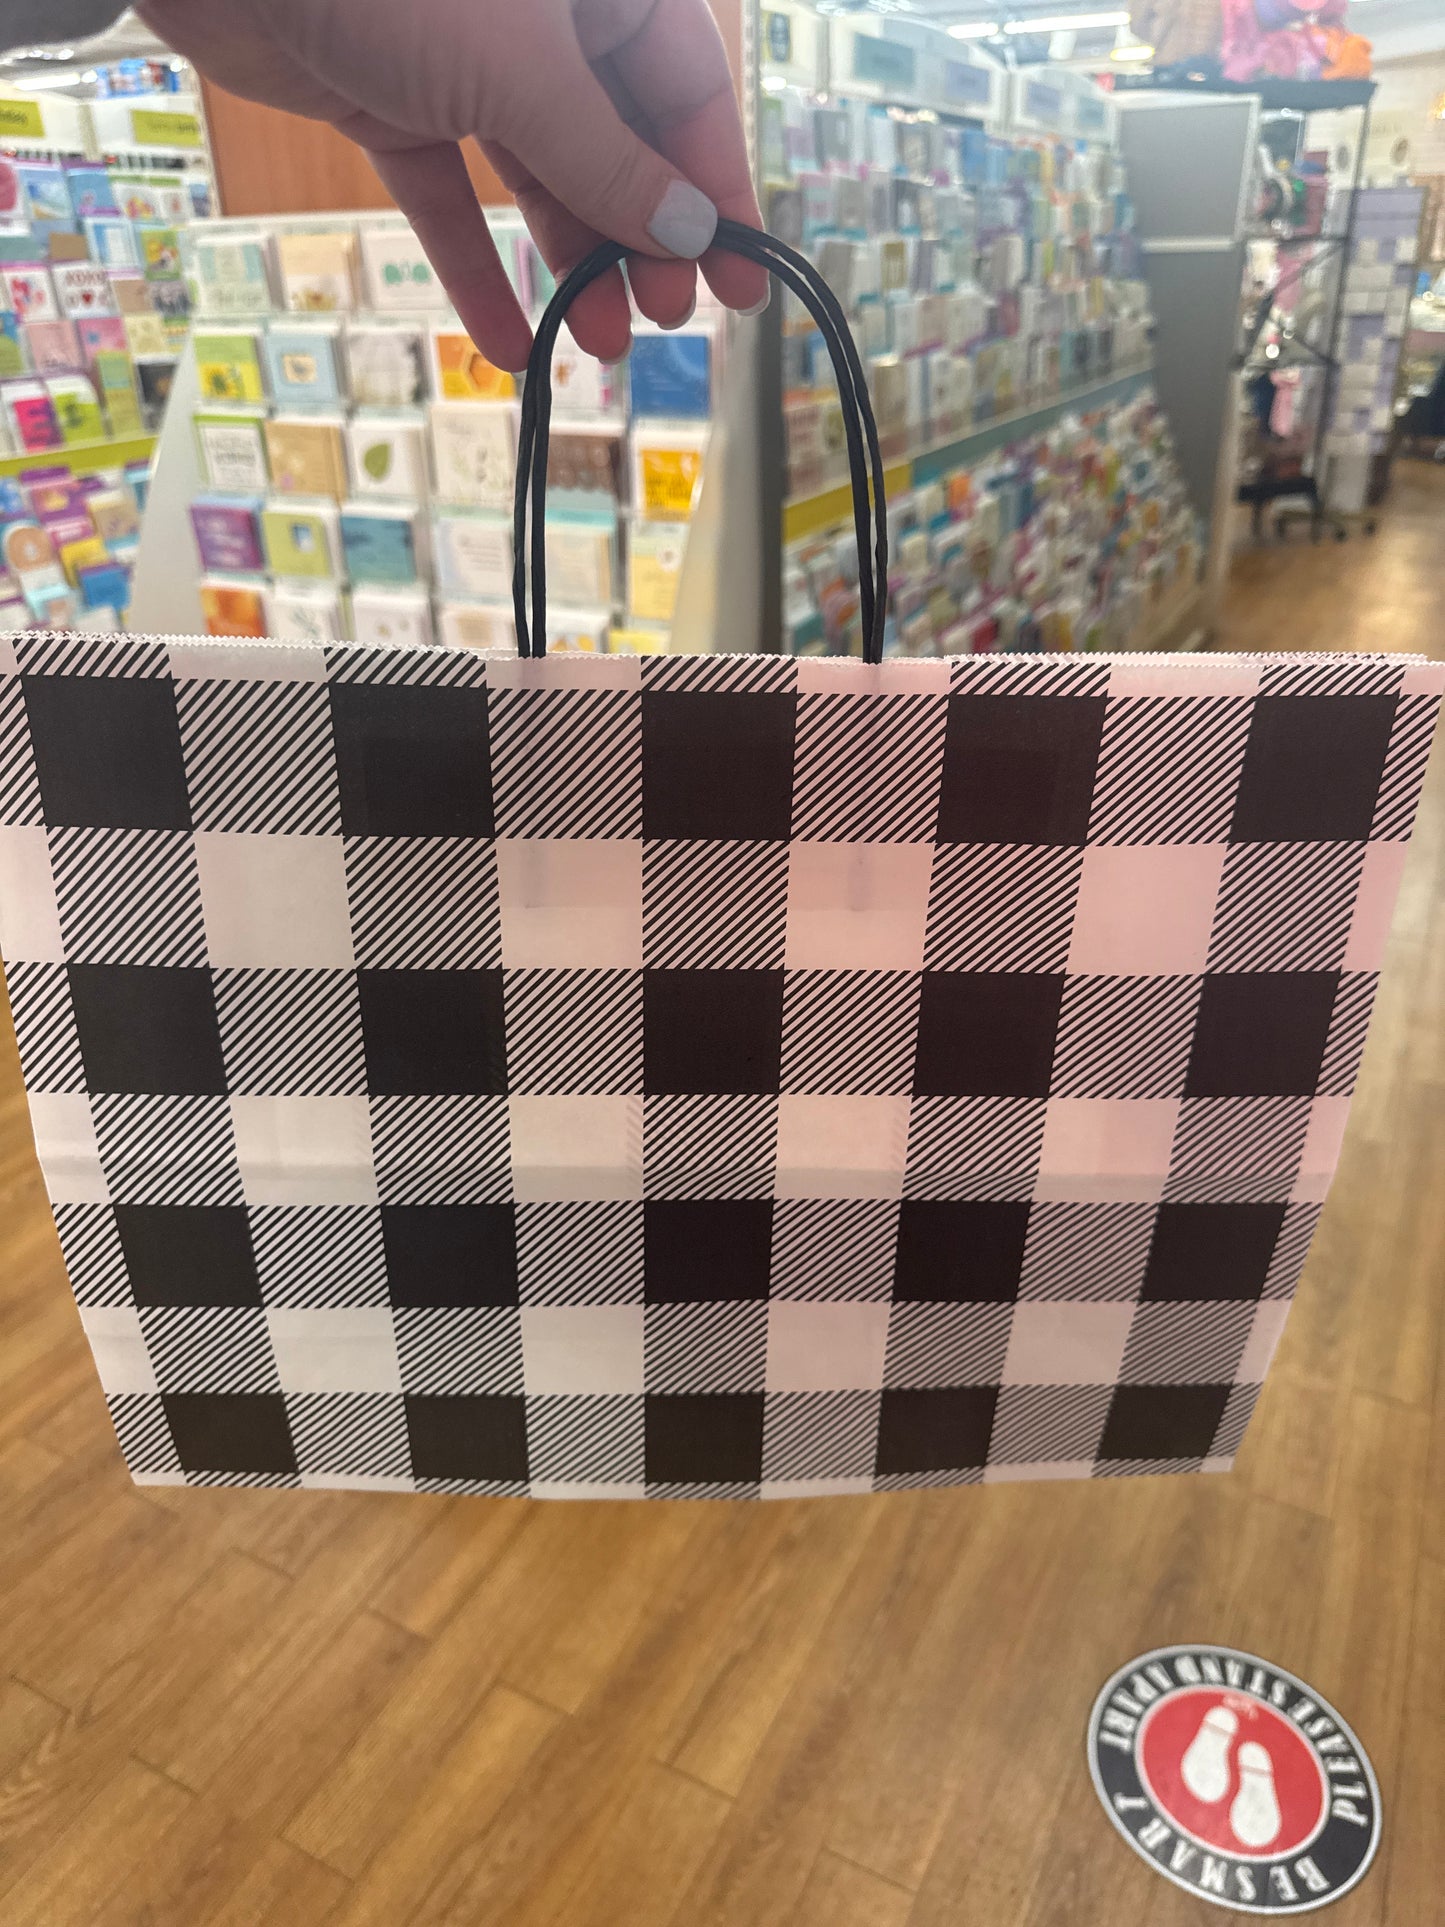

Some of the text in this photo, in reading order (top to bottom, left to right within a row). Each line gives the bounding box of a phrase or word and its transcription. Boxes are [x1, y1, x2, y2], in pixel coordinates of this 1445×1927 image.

[1099, 1655, 1368, 1826] PLEASE STAND APART
[1114, 1792, 1330, 1900] BE SMART
